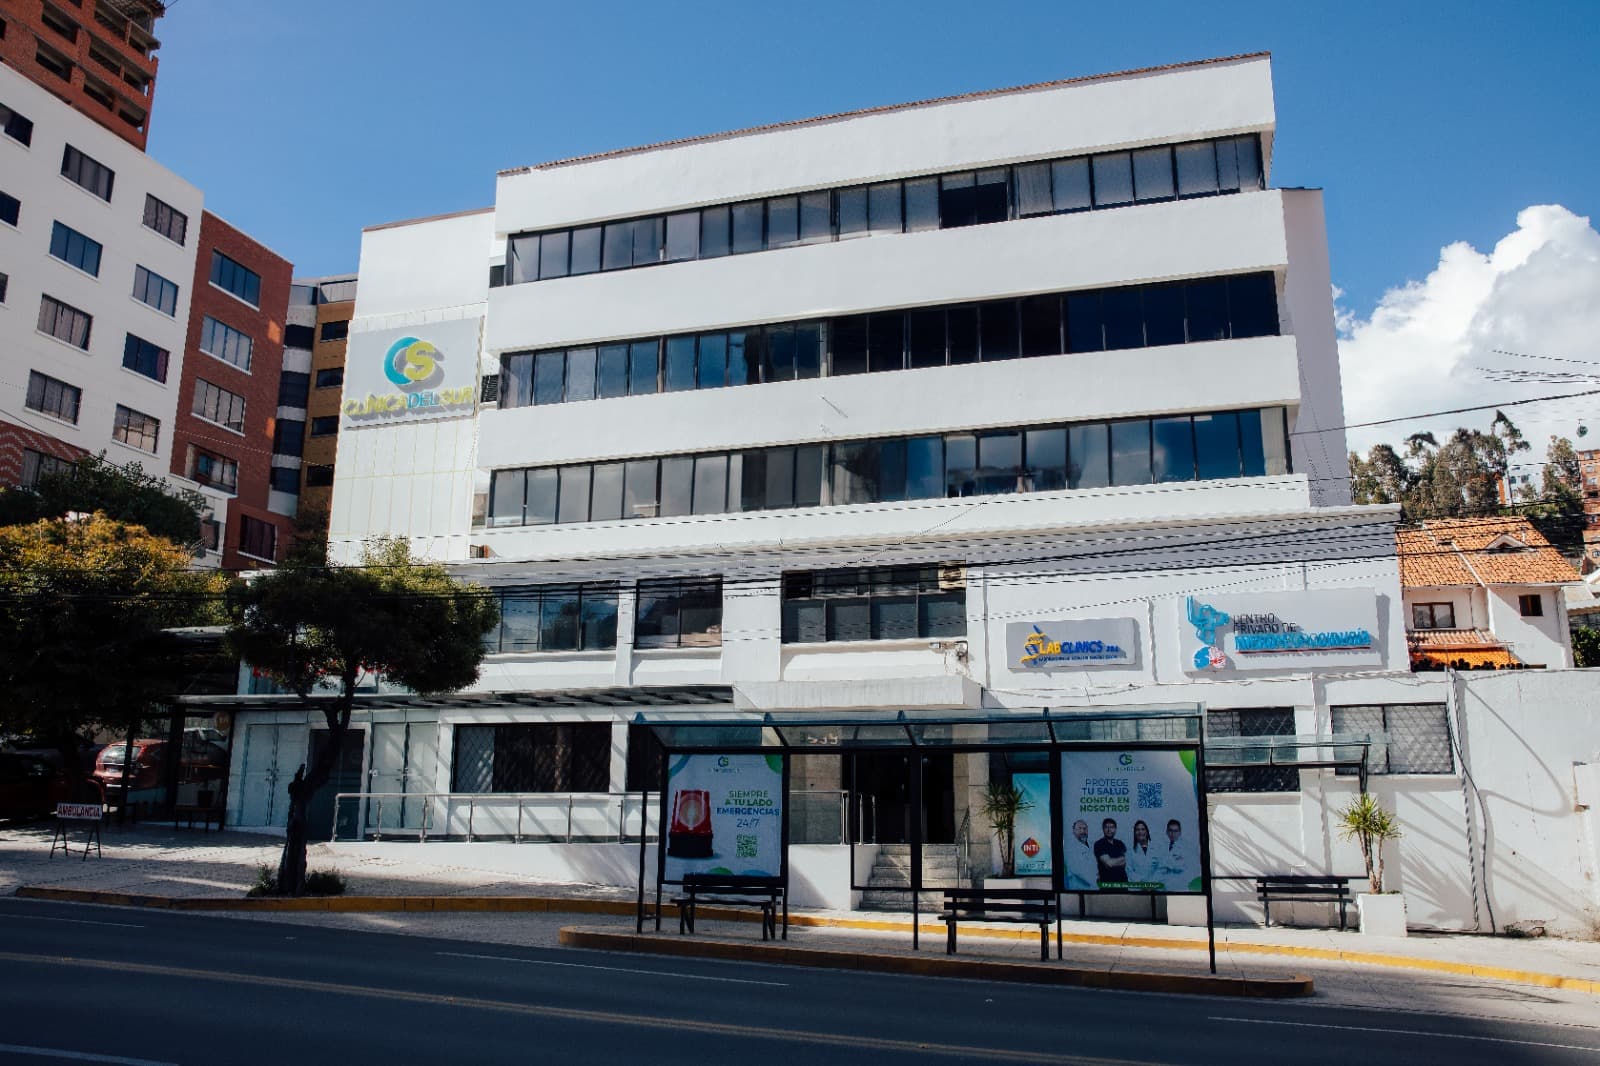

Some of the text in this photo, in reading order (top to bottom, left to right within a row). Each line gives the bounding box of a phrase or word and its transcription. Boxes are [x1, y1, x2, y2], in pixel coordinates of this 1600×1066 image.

[407, 391, 438, 410] DEL
[440, 387, 473, 405] SUR
[1233, 612, 1275, 625] CENTRO
[1233, 622, 1297, 635] PRIVADO DE
[1085, 778, 1129, 787] PROTEGE
[729, 790, 768, 798] SIEMPRE
[1082, 787, 1130, 796] TU SALUD
[734, 799, 745, 807] TU
[747, 799, 773, 807] LADO
[1117, 796, 1130, 804] EN
[58, 804, 99, 817] AMBULANCIA
[716, 808, 780, 816] EMERGENCIAS
[1080, 804, 1130, 813] NOSOTROS
[736, 818, 760, 828] 24/7
